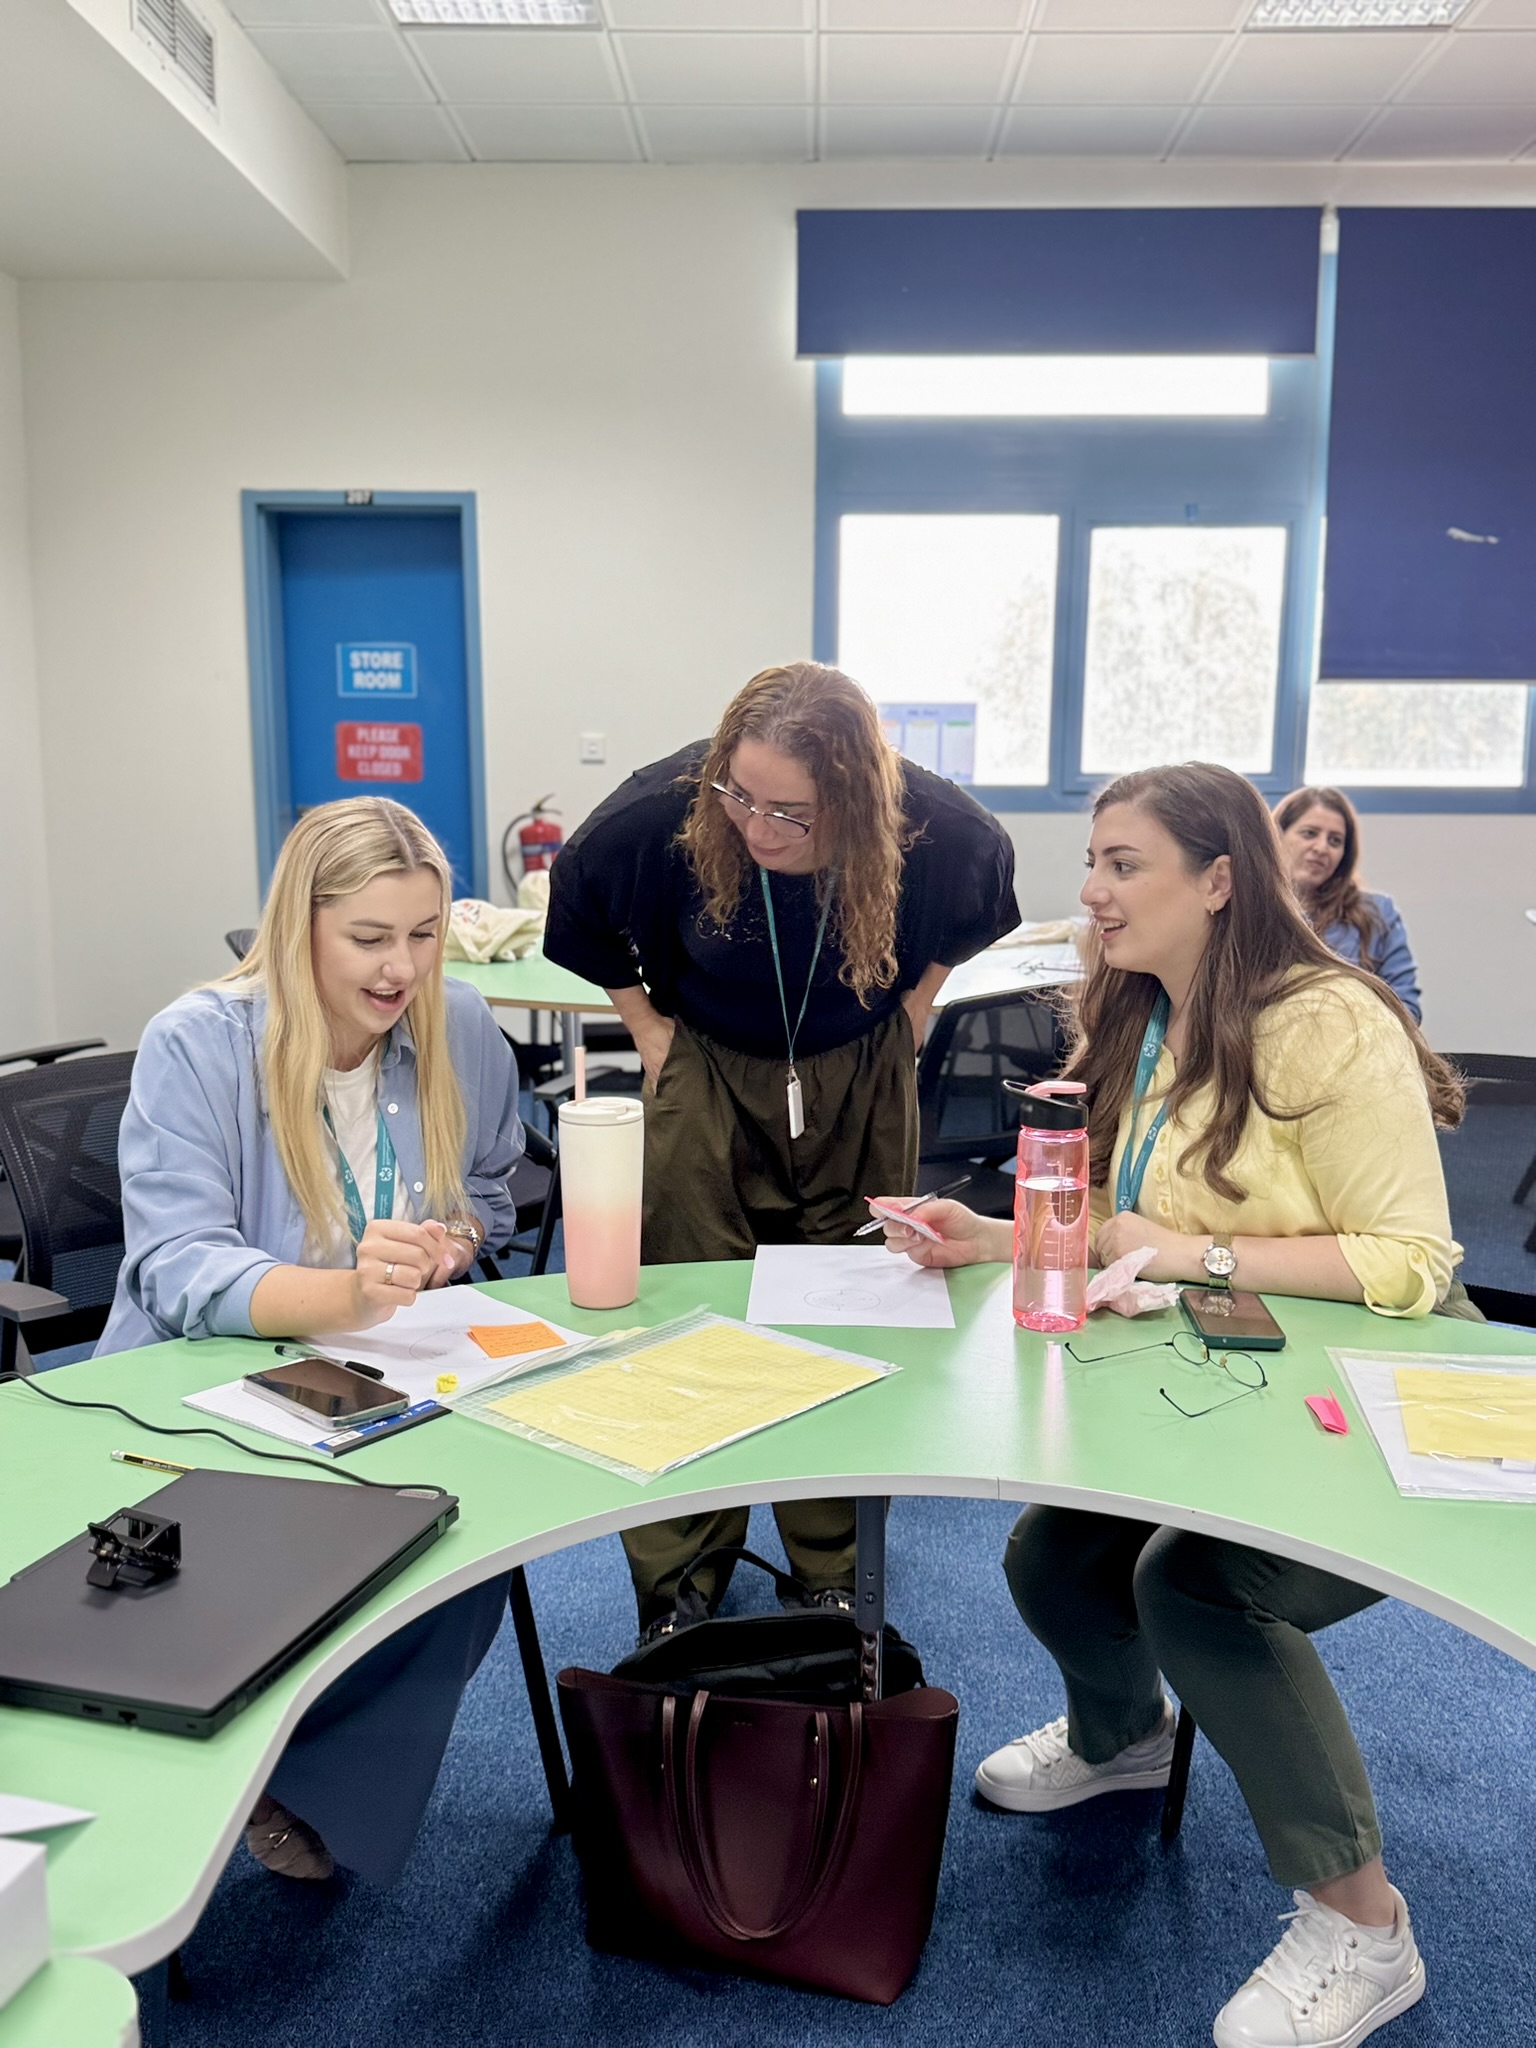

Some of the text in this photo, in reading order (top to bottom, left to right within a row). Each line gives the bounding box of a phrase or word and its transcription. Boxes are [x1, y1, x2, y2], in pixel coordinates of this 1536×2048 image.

[350, 651, 403, 669] STORE
[353, 671, 402, 690] ROOM
[356, 727, 399, 743] PLEASE
[347, 744, 377, 758] KEEP
[379, 745, 410, 760] DOOR
[356, 761, 402, 776] CLOSED
